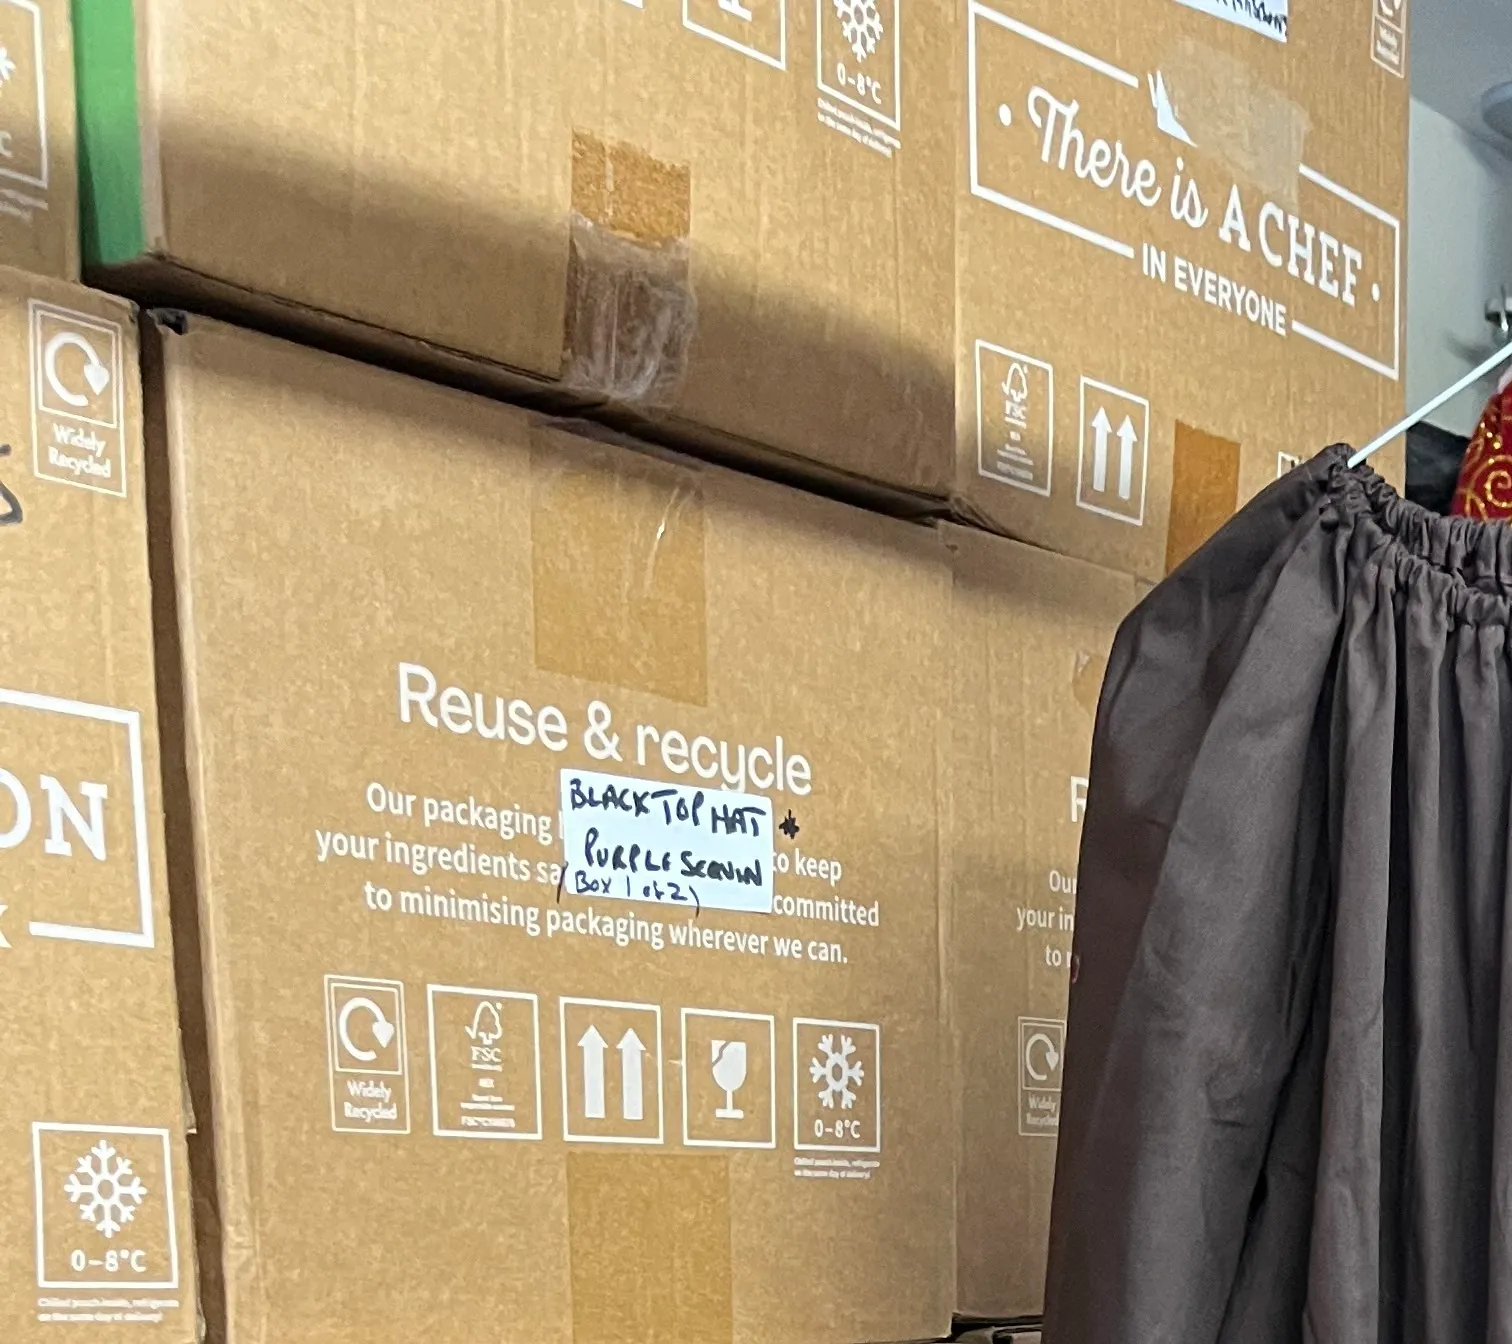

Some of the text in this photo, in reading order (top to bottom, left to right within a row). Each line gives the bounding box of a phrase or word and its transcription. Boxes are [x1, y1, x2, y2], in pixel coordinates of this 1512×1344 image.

[1027, 85, 1363, 308] There is A CHEF
[1142, 242, 1287, 337] IN EVERYONE
[397, 661, 812, 795] Reuse & recycle
[367, 782, 415, 816] Our
[423, 794, 553, 841] packaging
[569, 778, 767, 837] BLACK TOP HAT
[315, 827, 843, 886] your ingredients sa o keep
[585, 827, 671, 873] PURPLE
[364, 881, 850, 965] to minimising packaging wherever we can.
[773, 894, 881, 927] committed
[1016, 906, 1055, 932] your
[1045, 944, 1062, 966] to
[471, 1045, 502, 1062] FSC
[343, 1100, 398, 1122] Recycled
[347, 1079, 392, 1104] Widely
